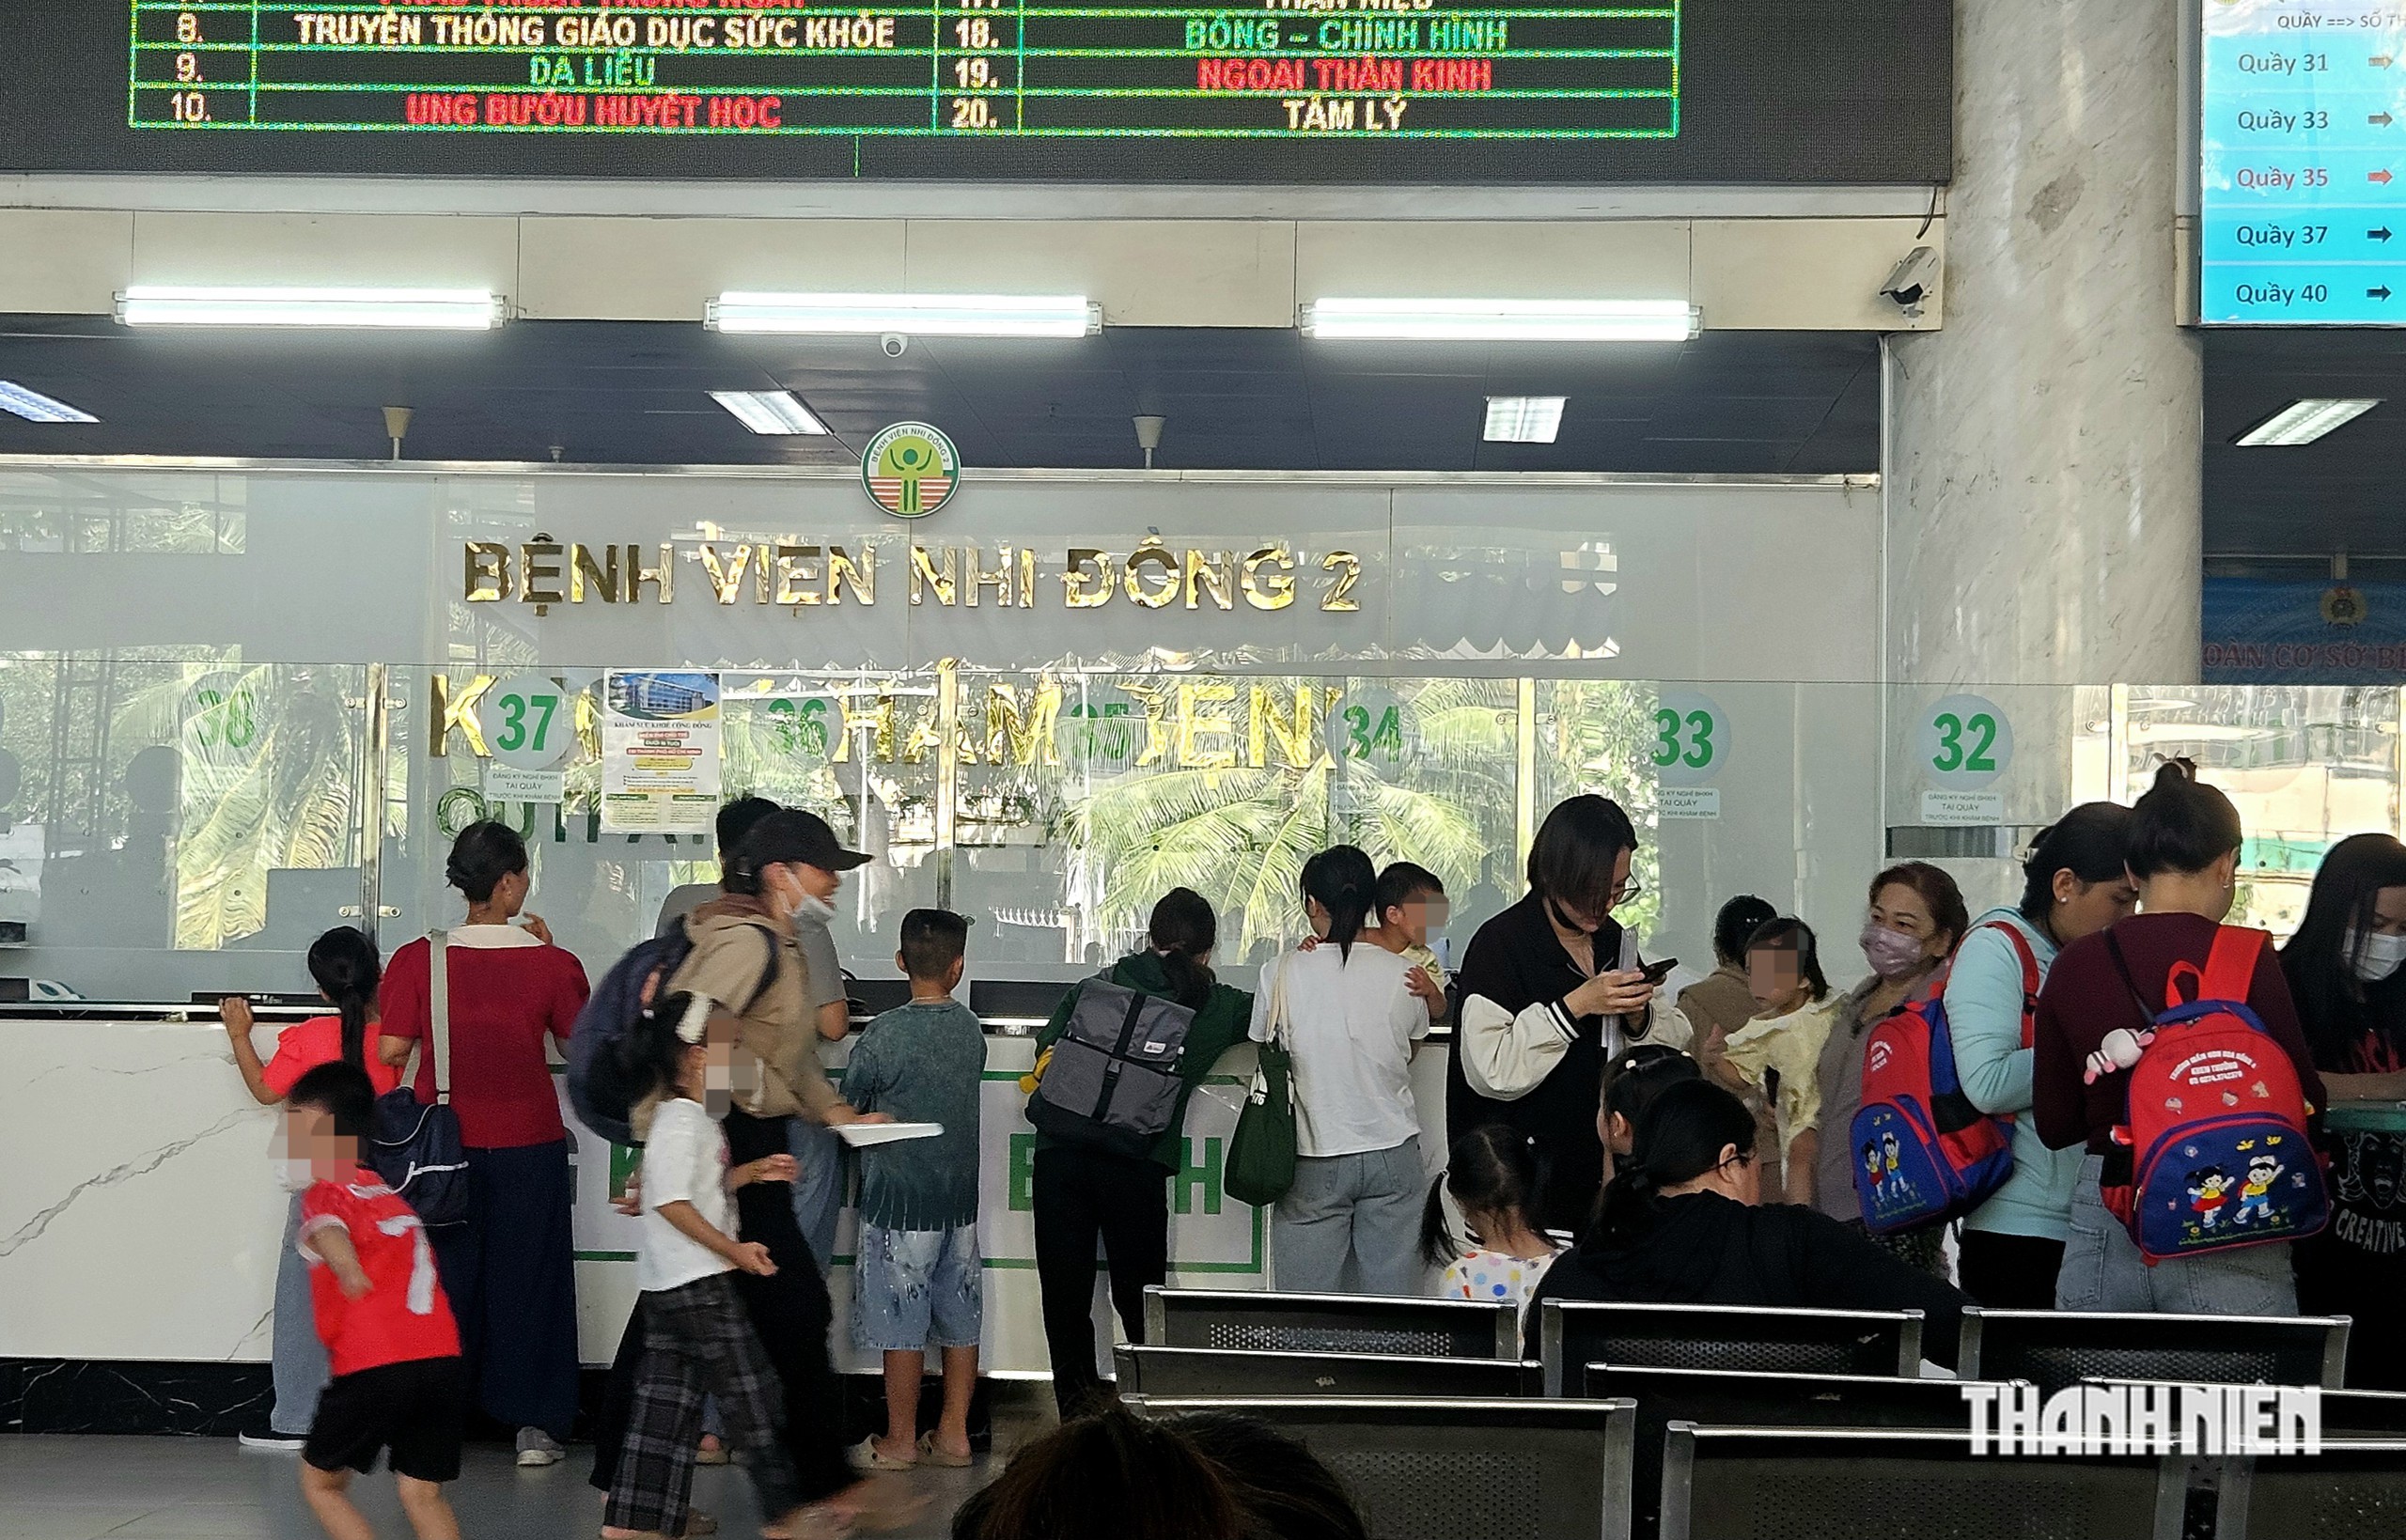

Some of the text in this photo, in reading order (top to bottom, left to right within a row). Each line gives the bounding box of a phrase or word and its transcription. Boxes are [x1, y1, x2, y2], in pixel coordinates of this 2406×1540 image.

[430, 9, 545, 45] THÔNG
[555, 8, 636, 45] GIÁO
[647, 17, 715, 50] DỤC
[724, 13, 797, 47] SỨC
[2277, 9, 2321, 29] QUẦY
[2360, 9, 2382, 27] SỐ
[530, 55, 576, 86] DA
[1412, 58, 1492, 91] KINH
[2238, 51, 2329, 75] Quầy 31
[709, 96, 782, 130] HỌC
[1282, 92, 1408, 131] TÂM LÝ
[2238, 108, 2329, 132] Quầy 33
[2237, 165, 2329, 190] Quầy 35
[2236, 224, 2328, 248] Quầy 37
[2236, 282, 2328, 306] Quầy 40
[911, 428, 927, 437] NHI
[465, 532, 675, 617] BỆNH
[911, 545, 1034, 609] NHI
[1060, 526, 1294, 611] ĐỒNG
[1320, 551, 1361, 611] 2
[2202, 636, 2266, 668] OÀN
[496, 693, 558, 751] 37
[1341, 706, 1401, 762] 34
[1650, 708, 1713, 768] 33
[1931, 712, 1997, 772] 32
[2336, 1208, 2406, 1252] CREATIVE
[377, 1215, 440, 1315] 7
